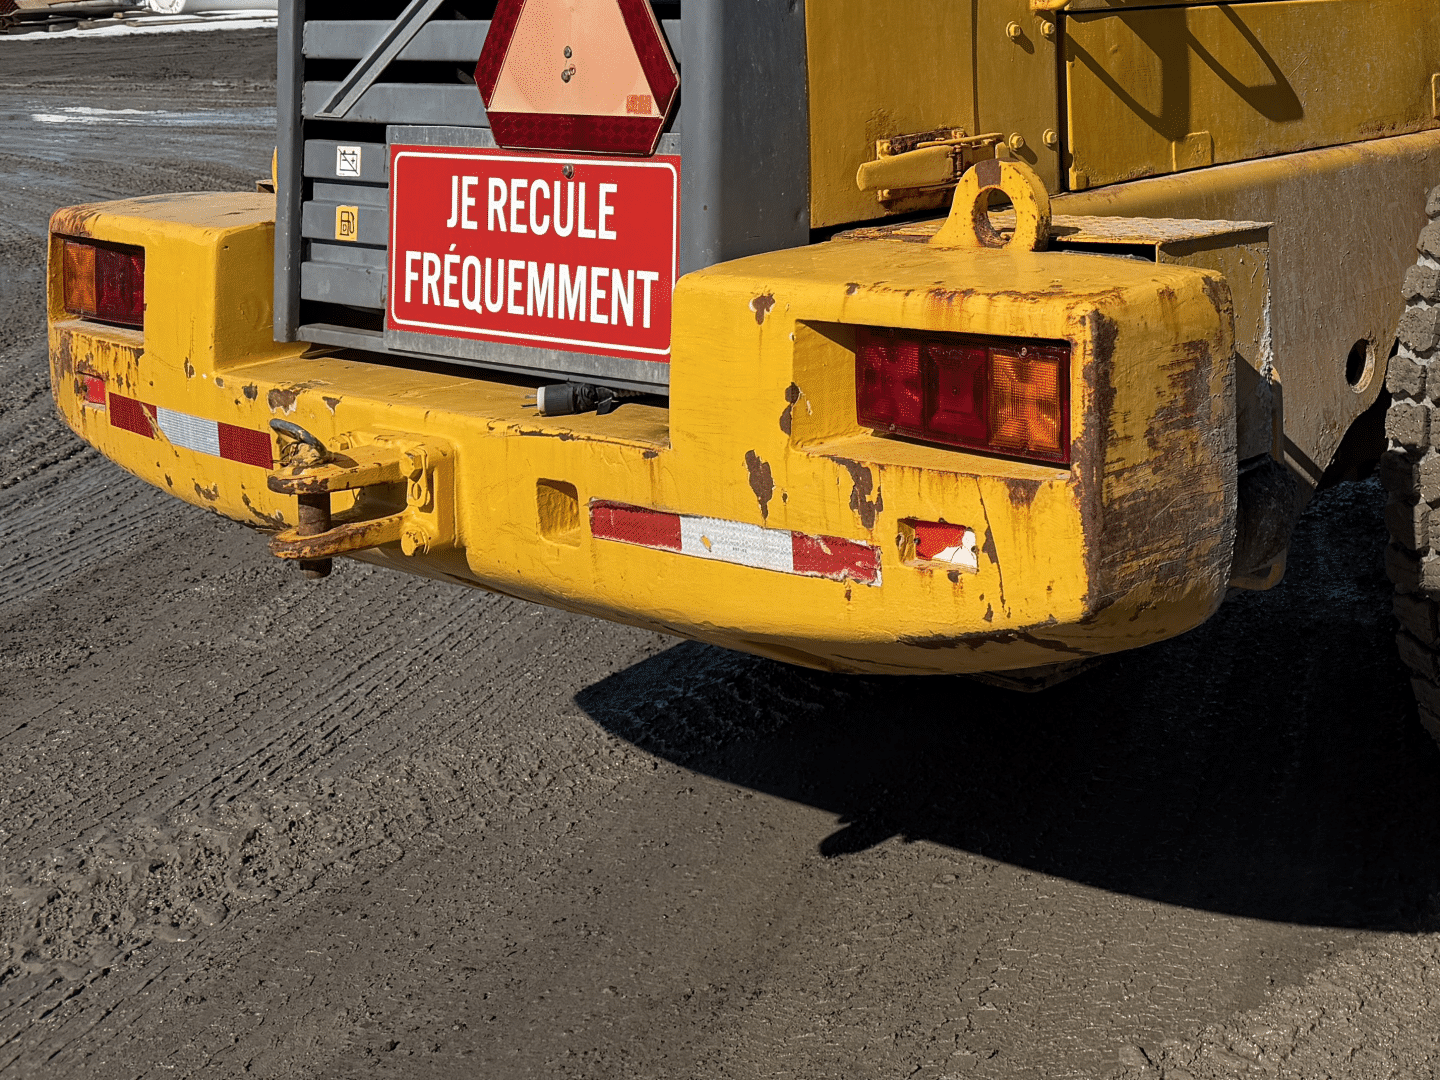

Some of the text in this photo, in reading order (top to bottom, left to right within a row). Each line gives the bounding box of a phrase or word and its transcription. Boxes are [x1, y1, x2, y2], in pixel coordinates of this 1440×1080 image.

[446, 175, 618, 241] JE RECULE
[404, 243, 659, 329] FRÉQUEMMENT
